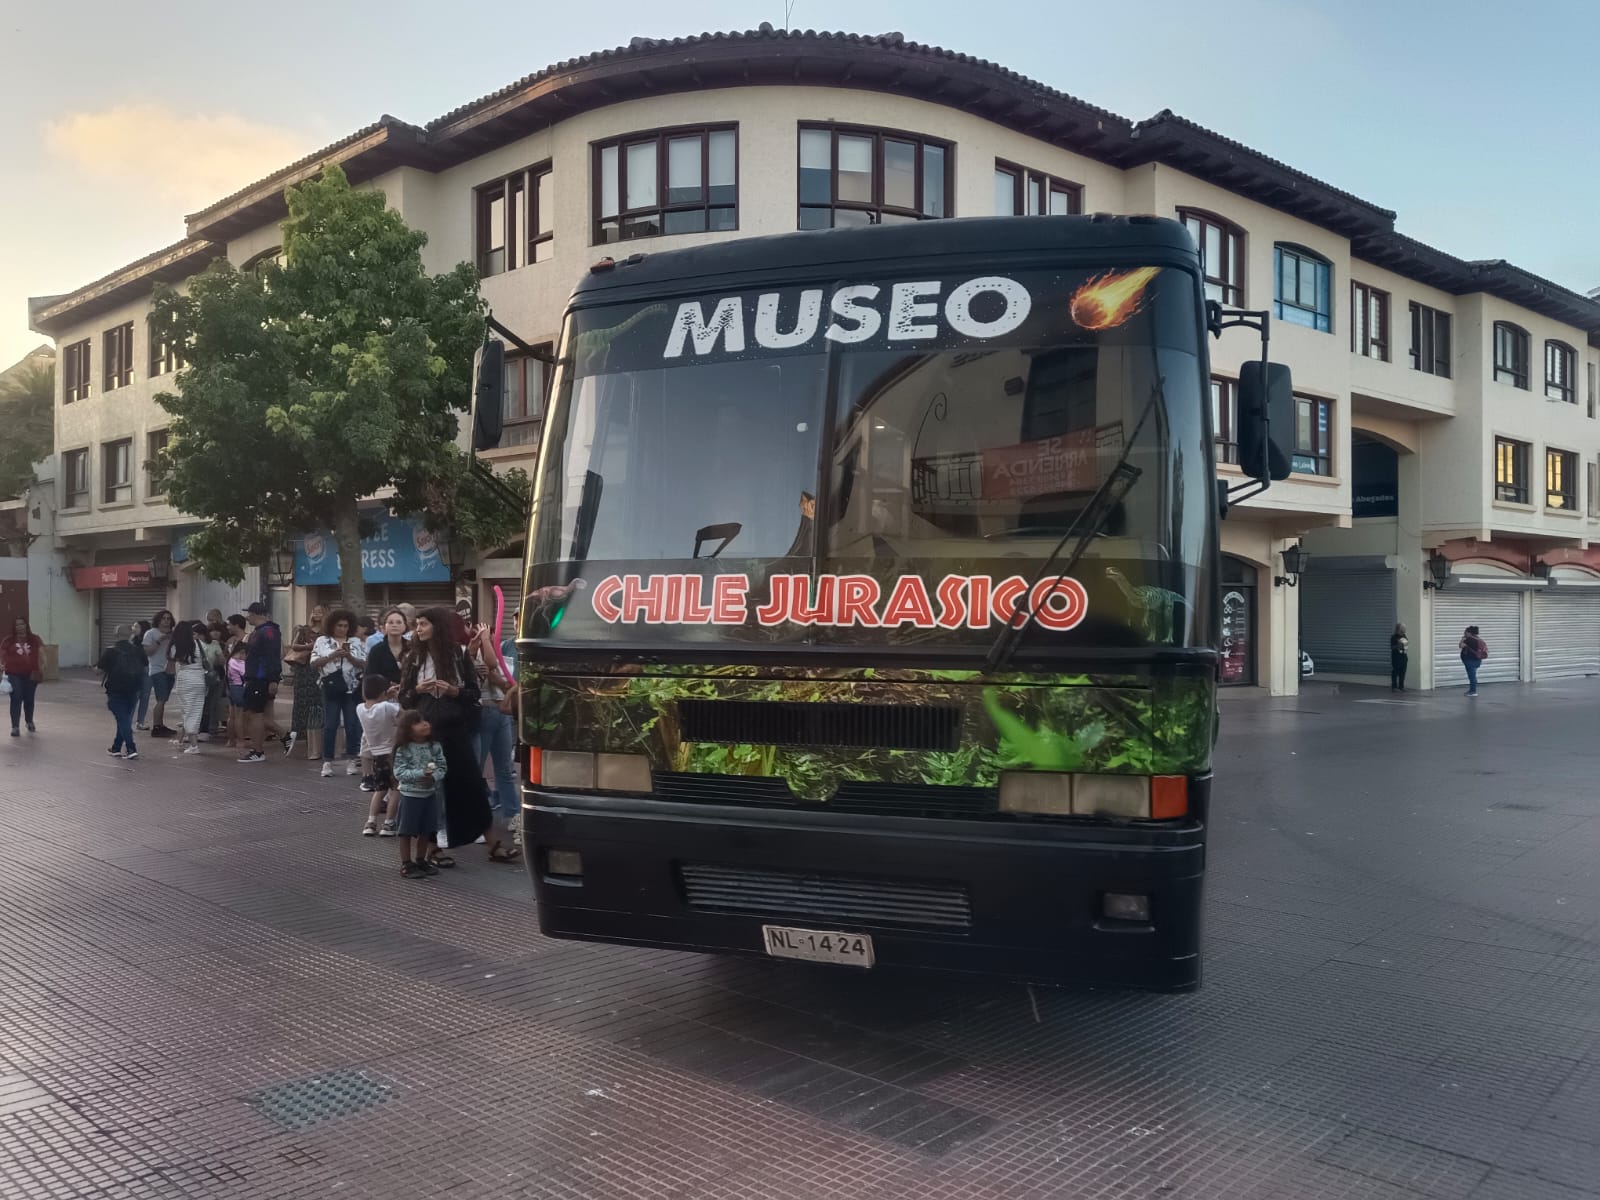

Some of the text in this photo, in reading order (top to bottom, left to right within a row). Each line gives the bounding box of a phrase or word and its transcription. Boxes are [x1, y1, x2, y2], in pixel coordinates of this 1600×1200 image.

[664, 276, 1031, 358] MUSEO
[592, 574, 1089, 631] CHILE JURASICO
